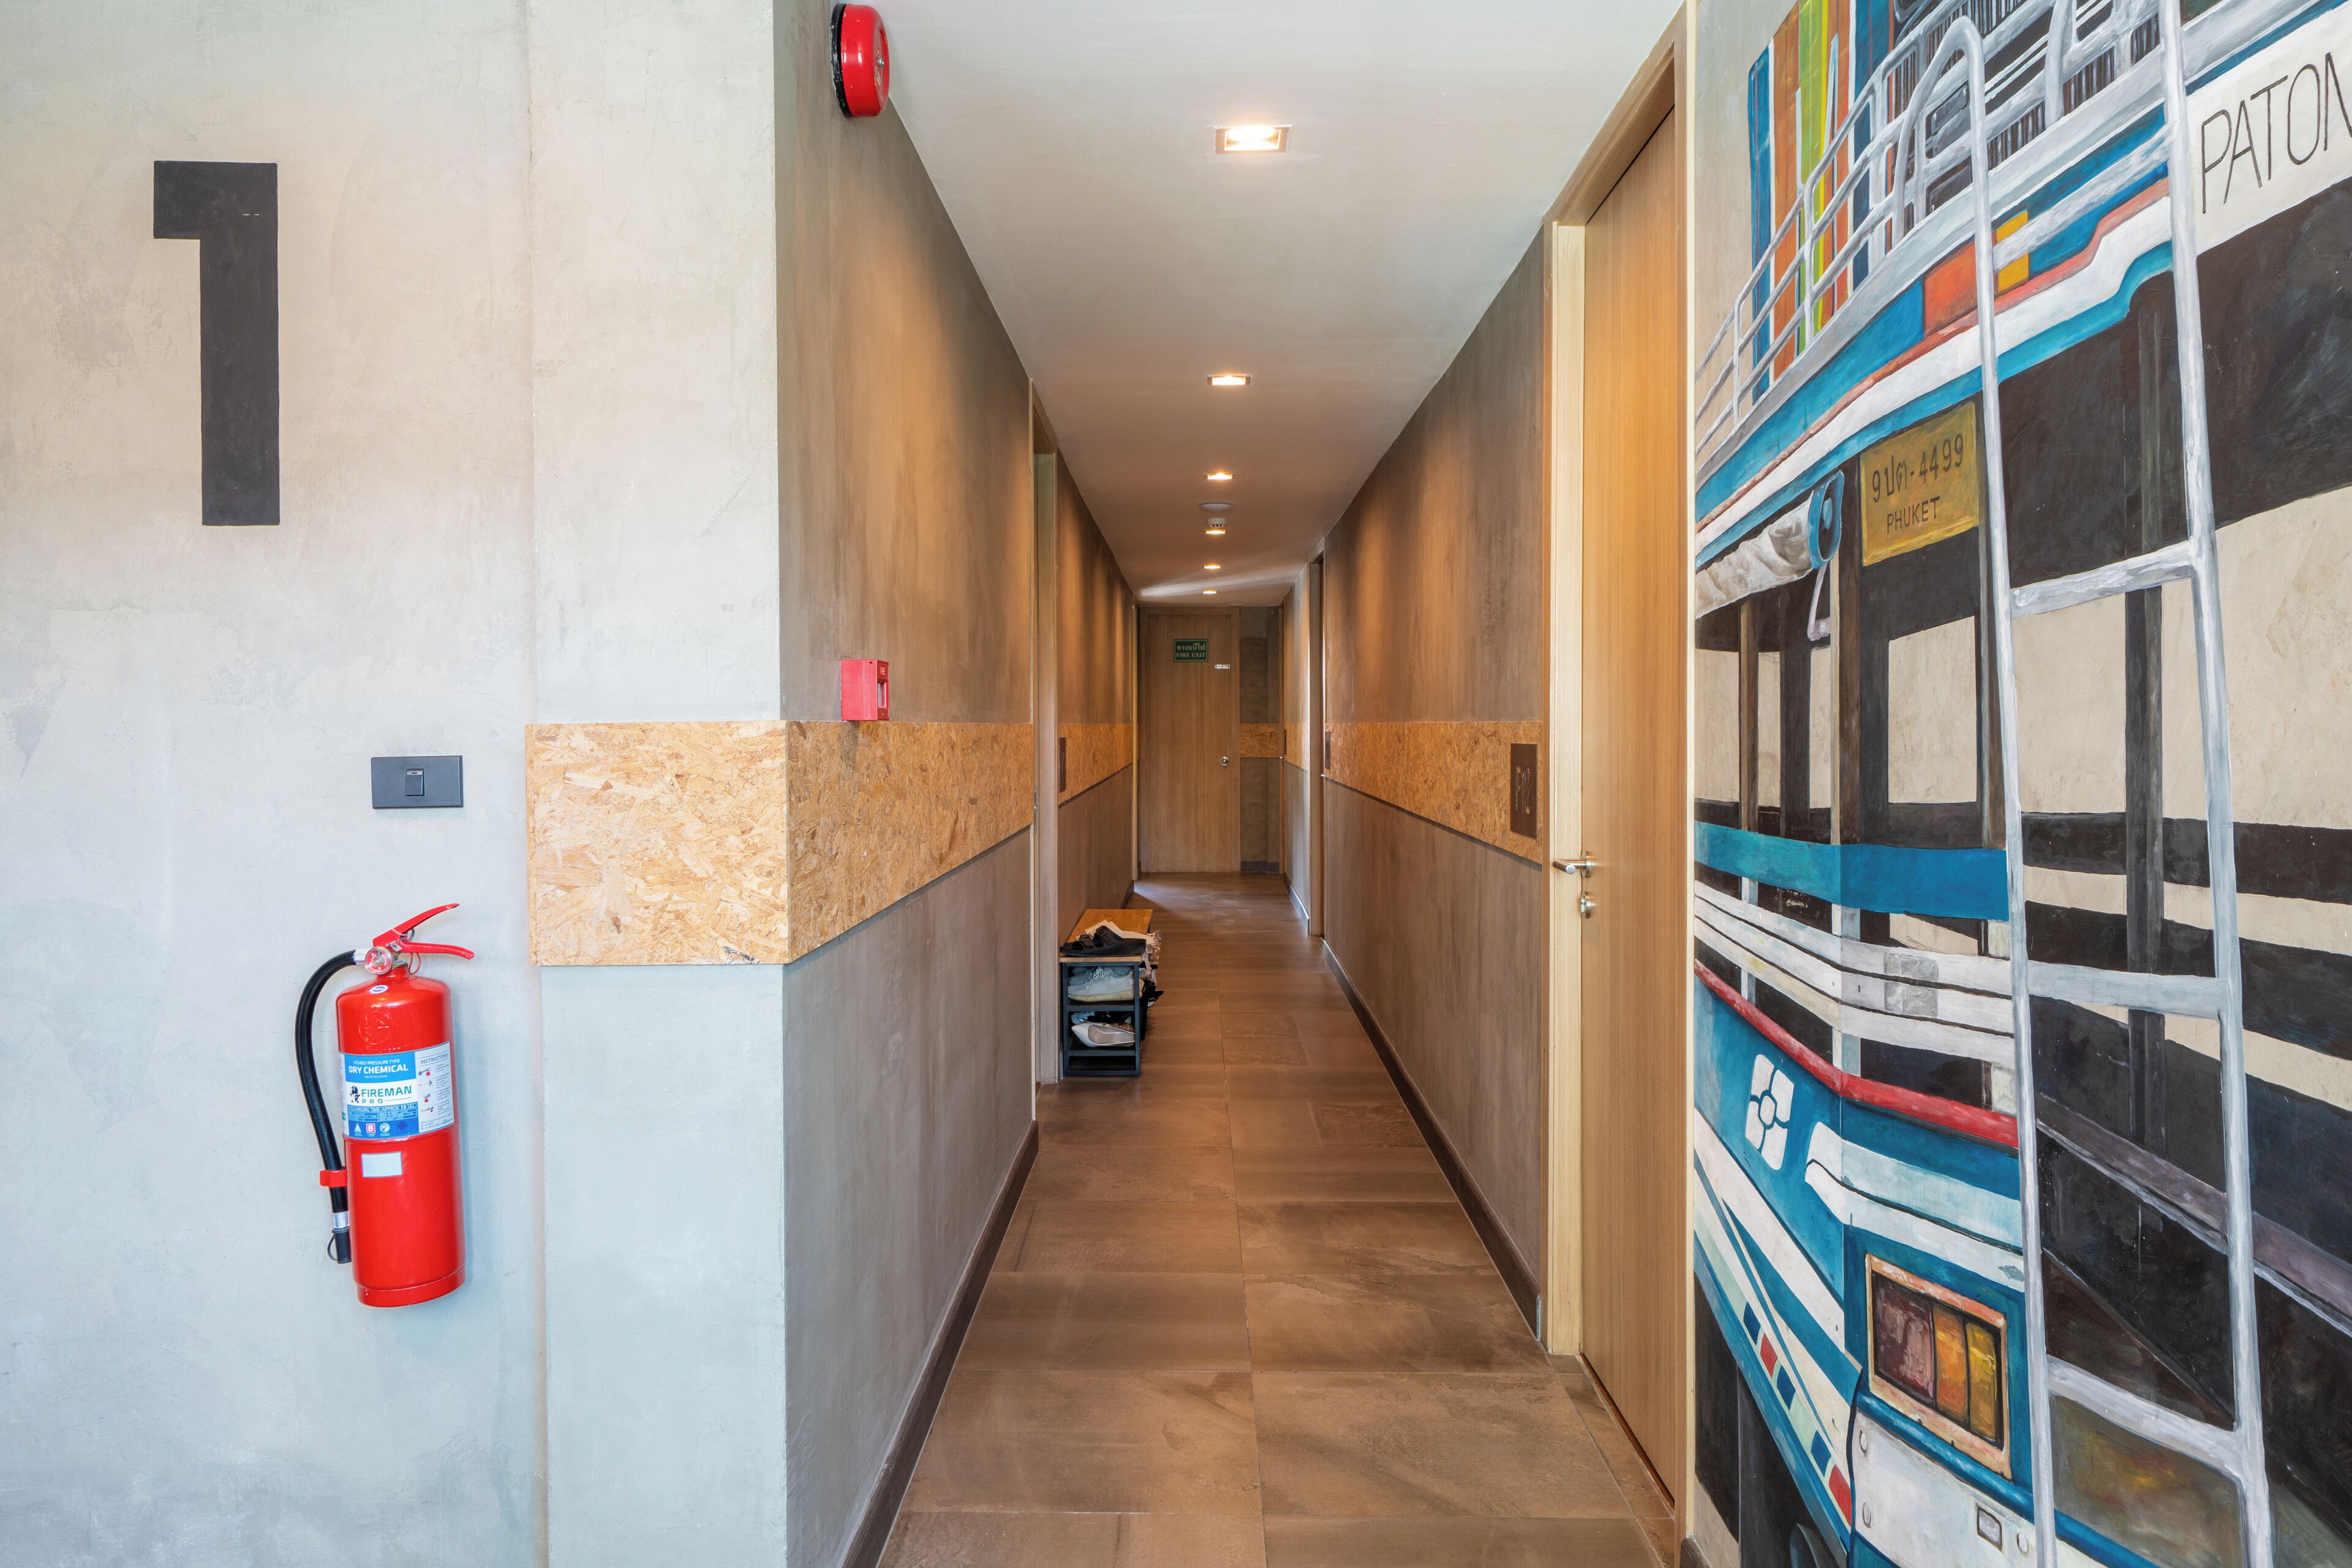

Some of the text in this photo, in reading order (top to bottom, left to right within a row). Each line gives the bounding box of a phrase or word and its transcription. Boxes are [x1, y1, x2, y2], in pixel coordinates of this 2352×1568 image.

[153, 160, 280, 526] 1
[1887, 496, 1940, 534] PHUKET
[420, 1053, 448, 1065] INSTRUCTIONS
[349, 1063, 409, 1074] DRY CHEMICAL
[361, 1085, 412, 1098] FIREMAN
